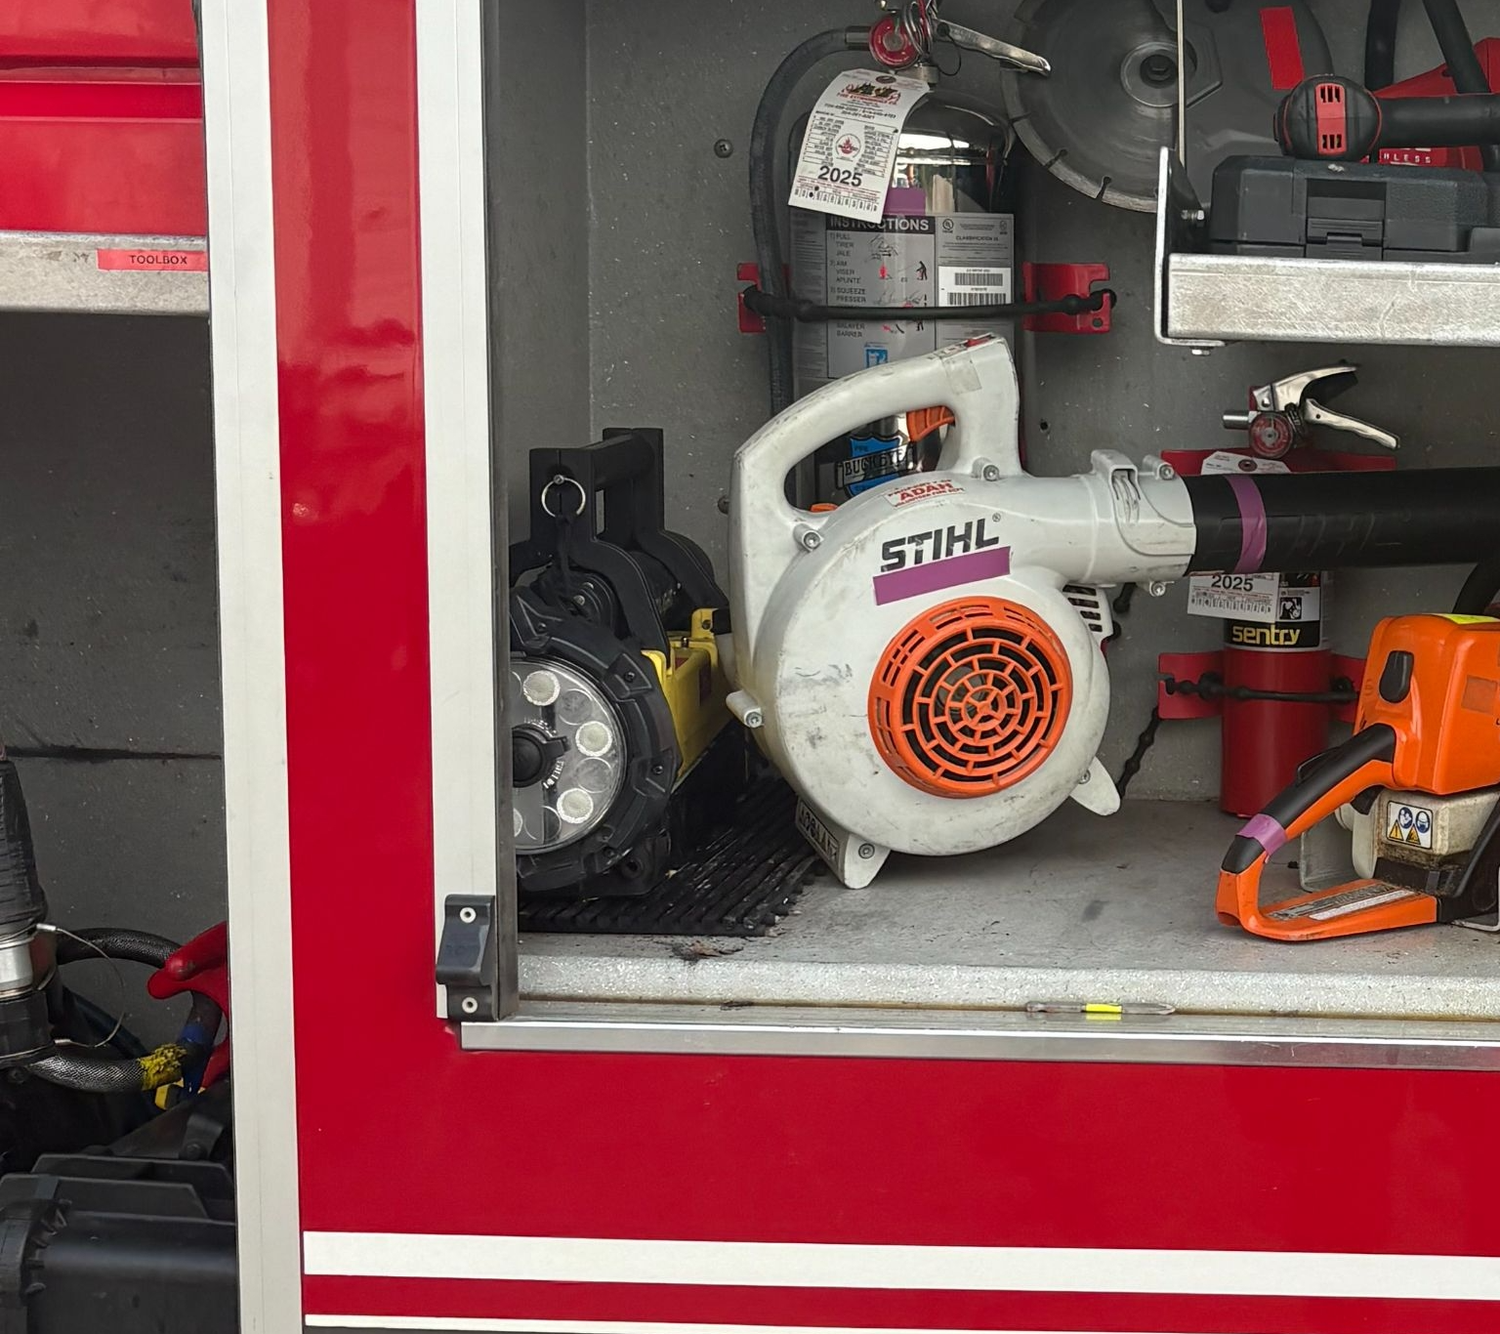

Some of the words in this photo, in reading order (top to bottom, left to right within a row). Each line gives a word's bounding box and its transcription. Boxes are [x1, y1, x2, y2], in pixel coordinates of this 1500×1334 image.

[817, 165, 864, 188] 2025
[129, 254, 188, 265] TOOLBOX
[880, 518, 1000, 573] STIHL
[1211, 575, 1254, 592] 2025
[1232, 624, 1301, 646] sentry
